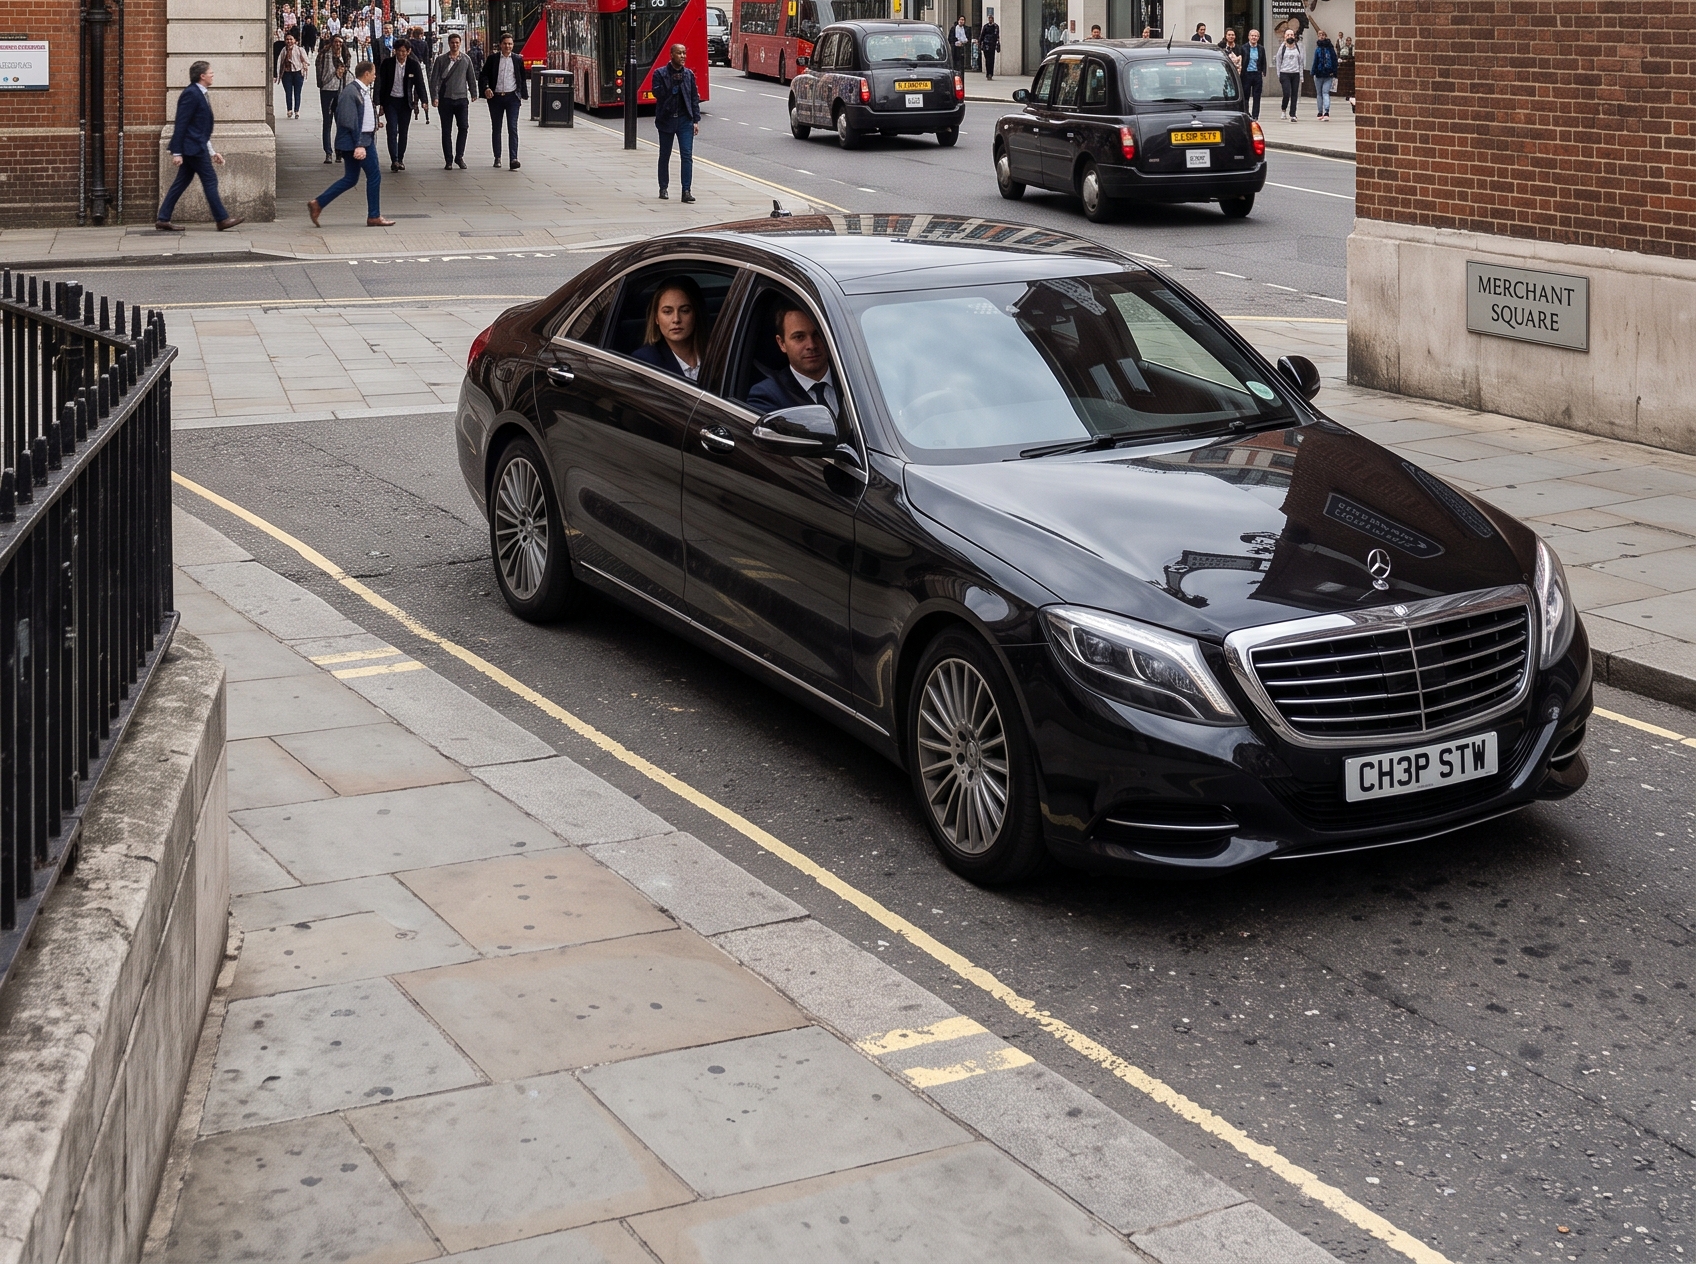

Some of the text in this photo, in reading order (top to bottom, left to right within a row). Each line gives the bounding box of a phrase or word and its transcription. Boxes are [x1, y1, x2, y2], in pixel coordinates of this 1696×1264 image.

[1478, 275, 1575, 307] MERCHANT
[1491, 303, 1560, 332] SQUARE
[1358, 738, 1486, 793] CH3P STW
